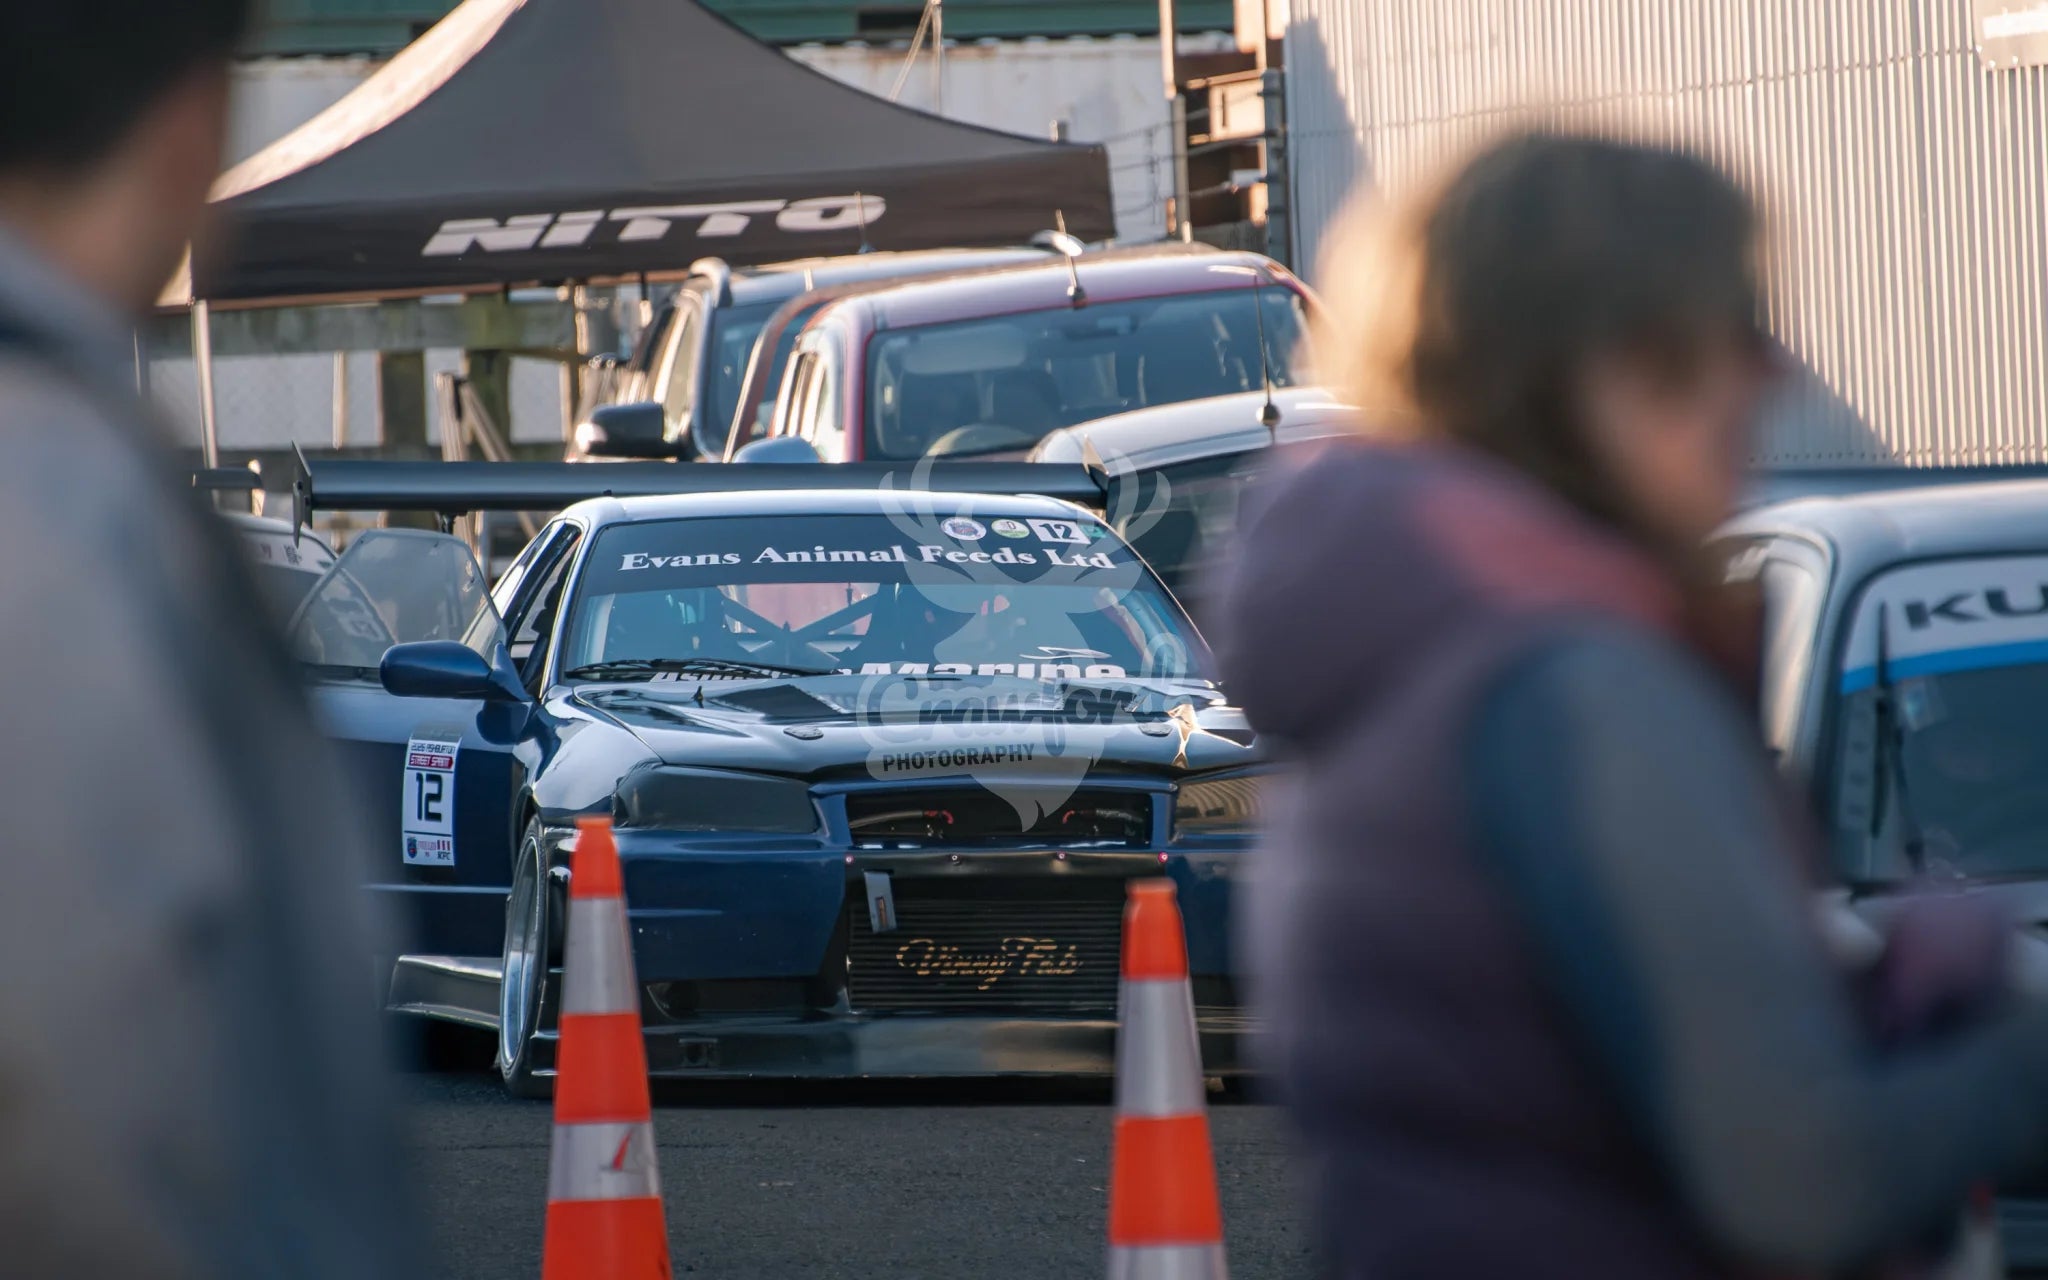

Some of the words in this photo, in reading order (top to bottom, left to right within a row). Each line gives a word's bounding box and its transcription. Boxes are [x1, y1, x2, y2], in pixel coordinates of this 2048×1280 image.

[421, 195, 886, 257] NITTO
[1038, 523, 1076, 540] 12
[618, 552, 742, 571] Evans
[752, 545, 907, 563] Animal
[917, 545, 1037, 565] Feeds
[1042, 548, 1116, 568] Ltd
[416, 772, 442, 822] 12
